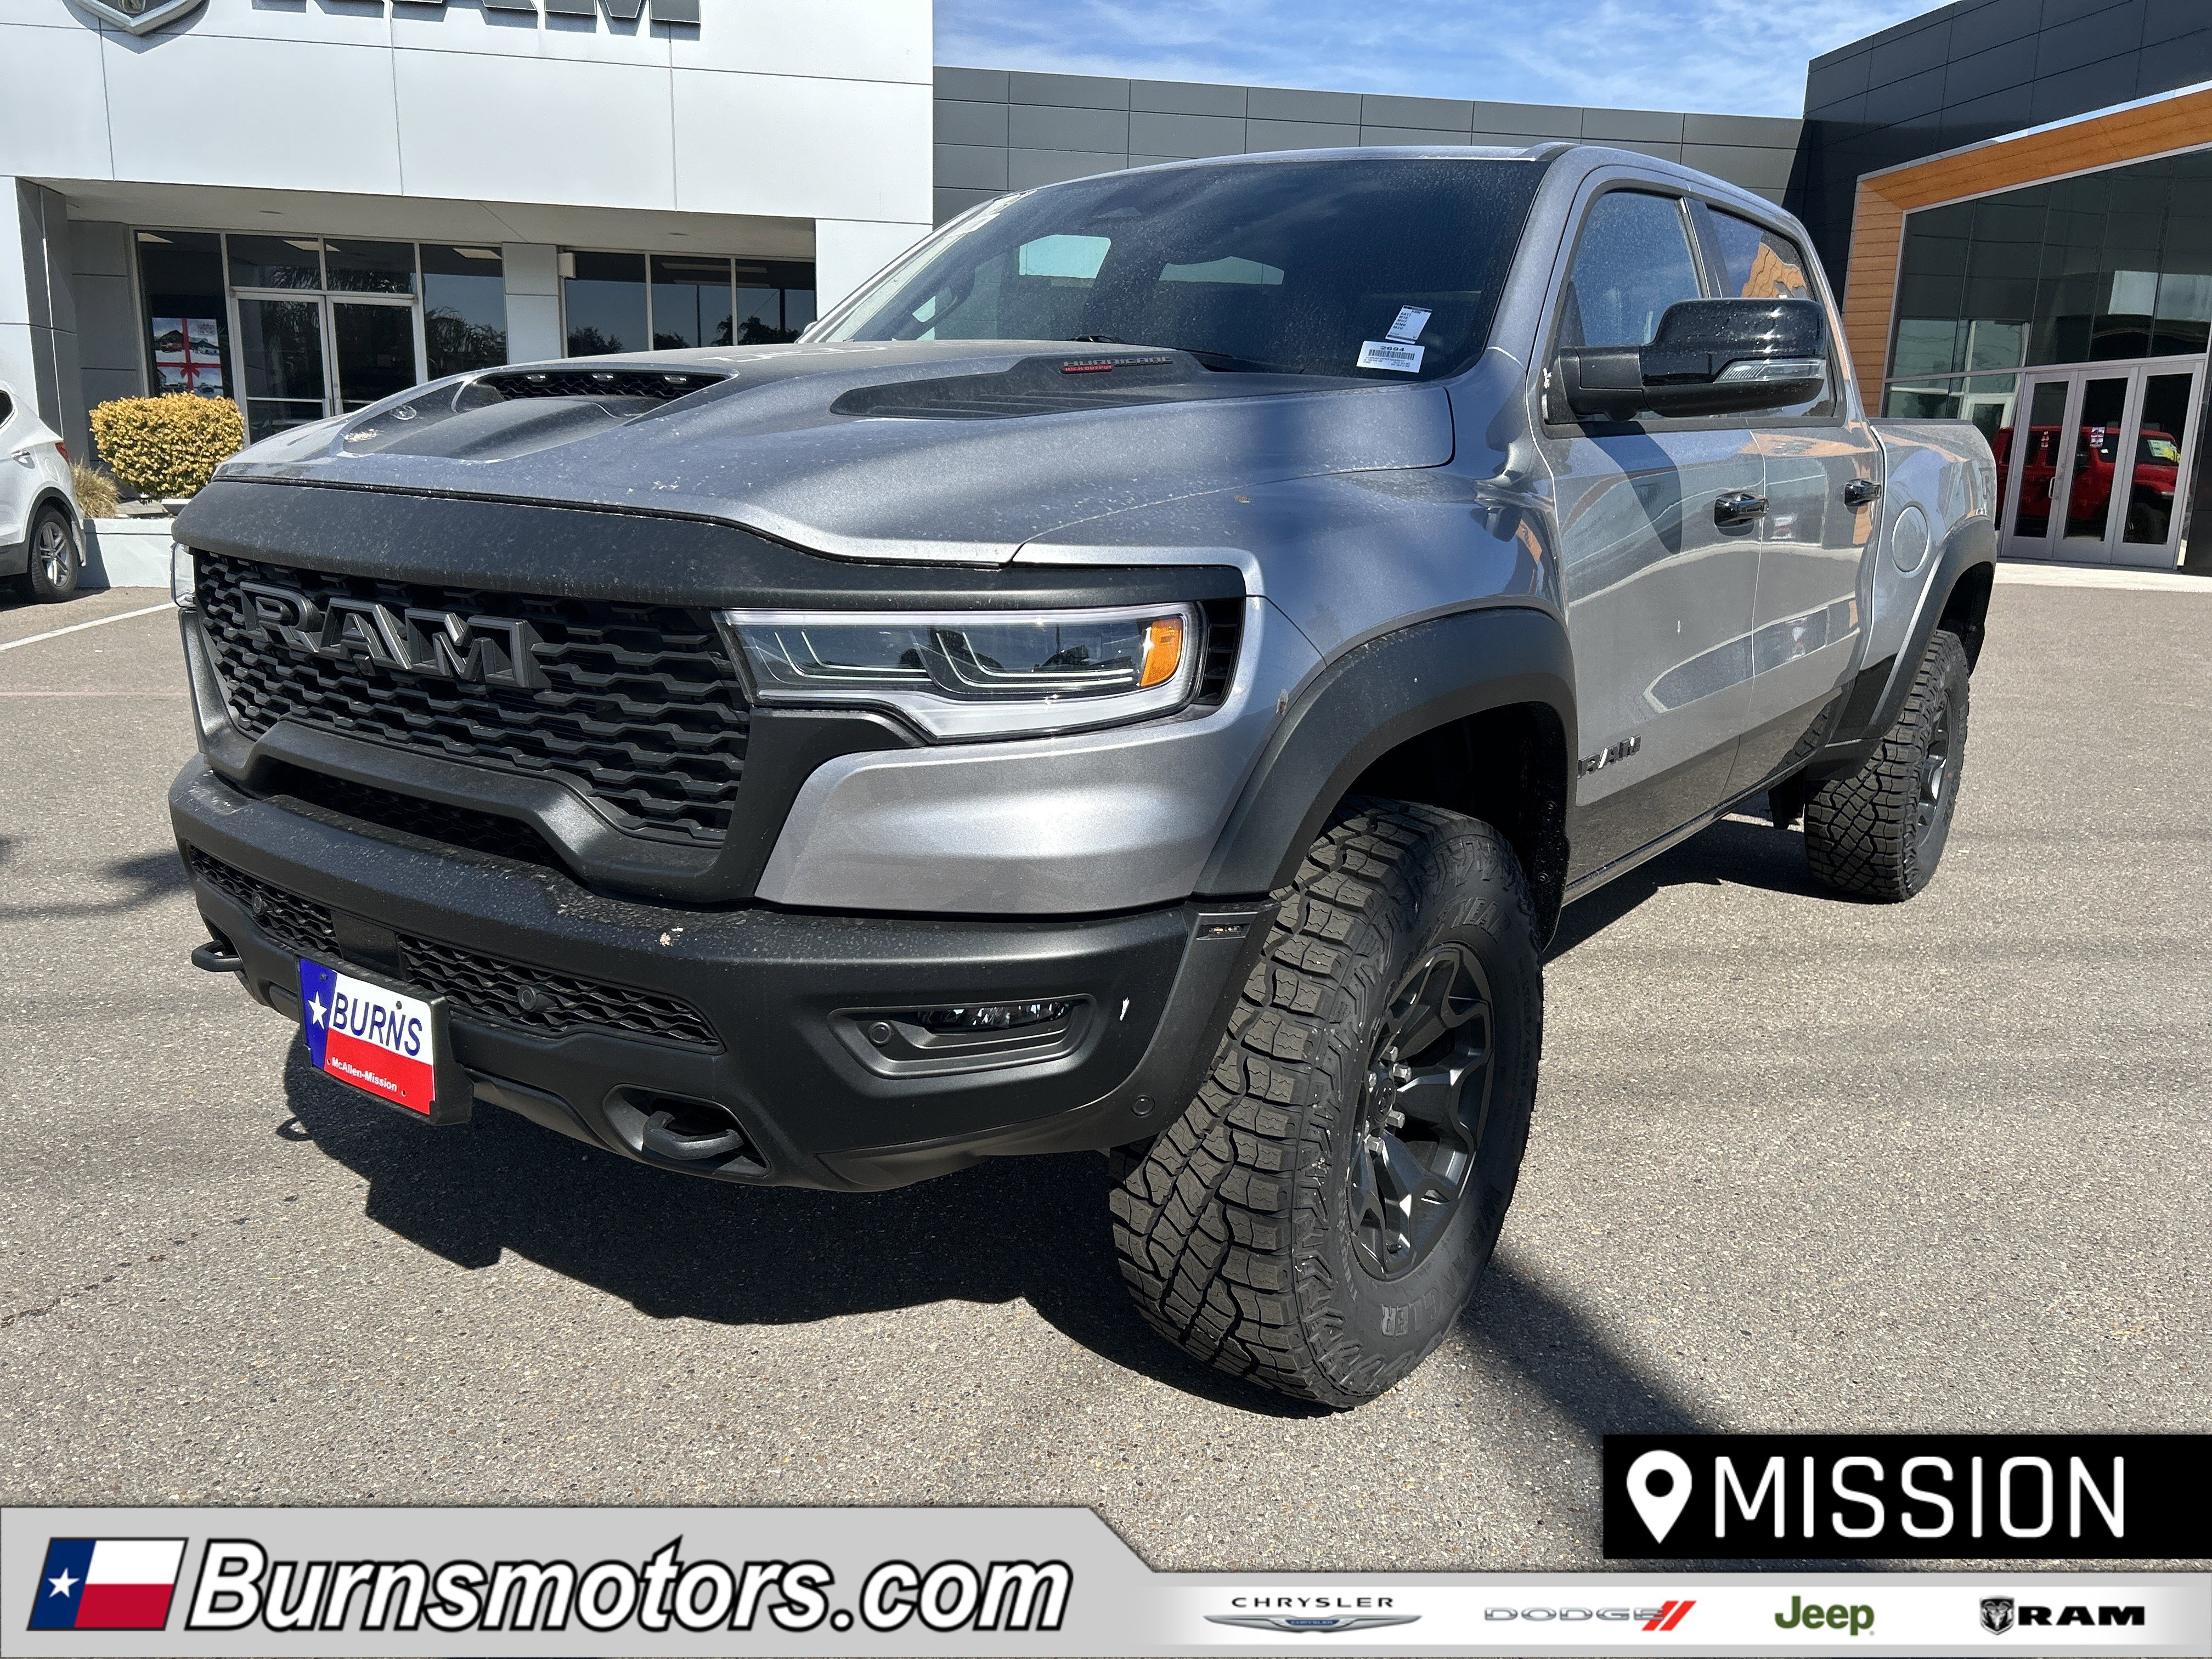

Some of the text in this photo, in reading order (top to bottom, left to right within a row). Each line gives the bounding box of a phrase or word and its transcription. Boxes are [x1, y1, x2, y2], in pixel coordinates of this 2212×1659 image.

[1064, 357, 1173, 367] HURRICANE
[240, 580, 552, 689] RAM
[1578, 734, 1641, 778] RAM
[332, 991, 422, 1057] BURNS
[331, 1056, 398, 1093] McAllen-Mission
